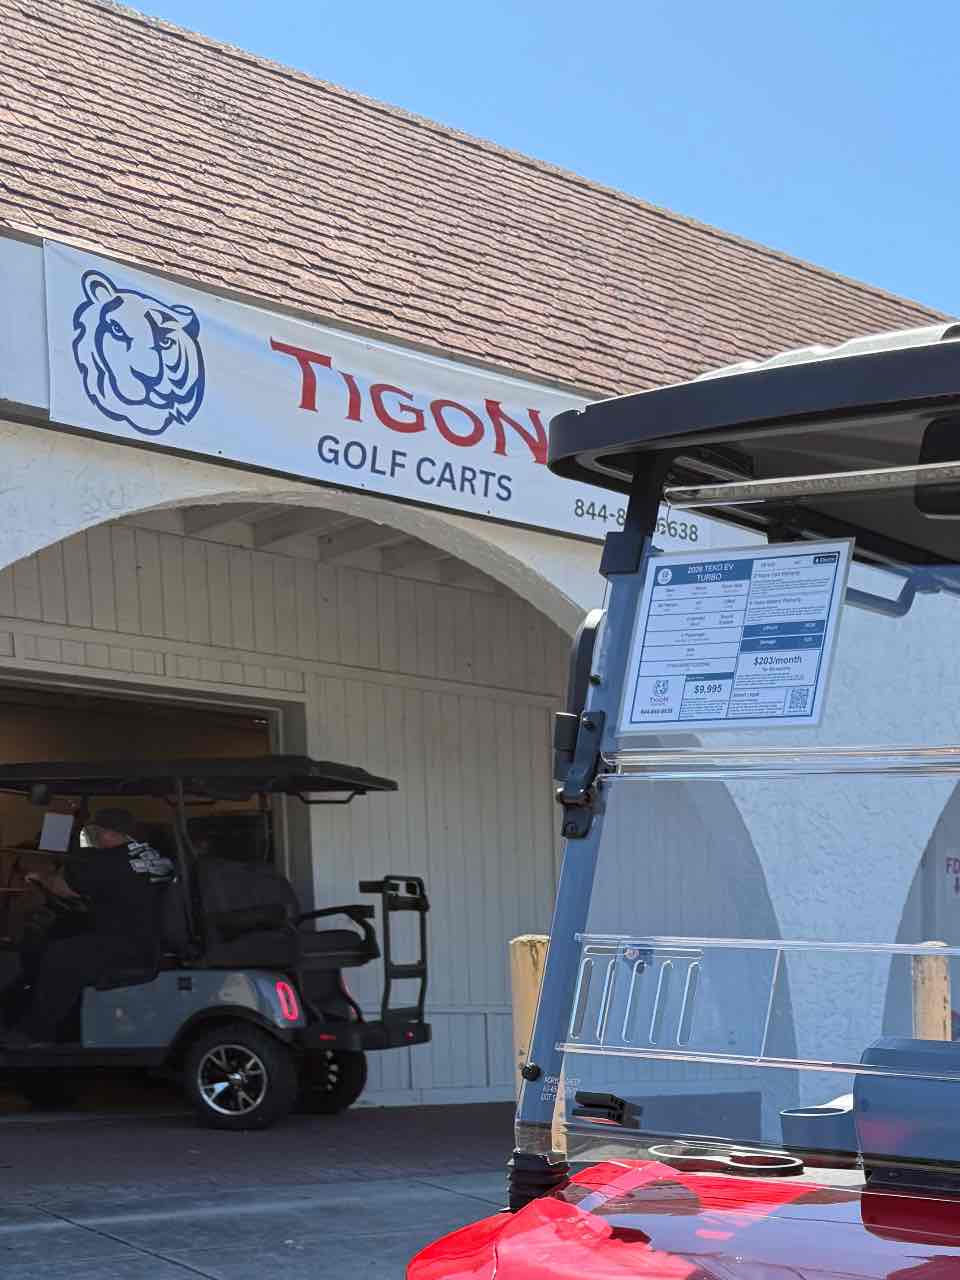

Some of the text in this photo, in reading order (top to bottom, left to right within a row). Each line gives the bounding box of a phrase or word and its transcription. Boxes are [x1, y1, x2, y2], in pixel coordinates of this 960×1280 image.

[270, 336, 548, 465] TIGON
[317, 434, 513, 501] GOLF CARTS
[696, 573, 722, 582] TURBO
[753, 655, 802, 667] $203/month
